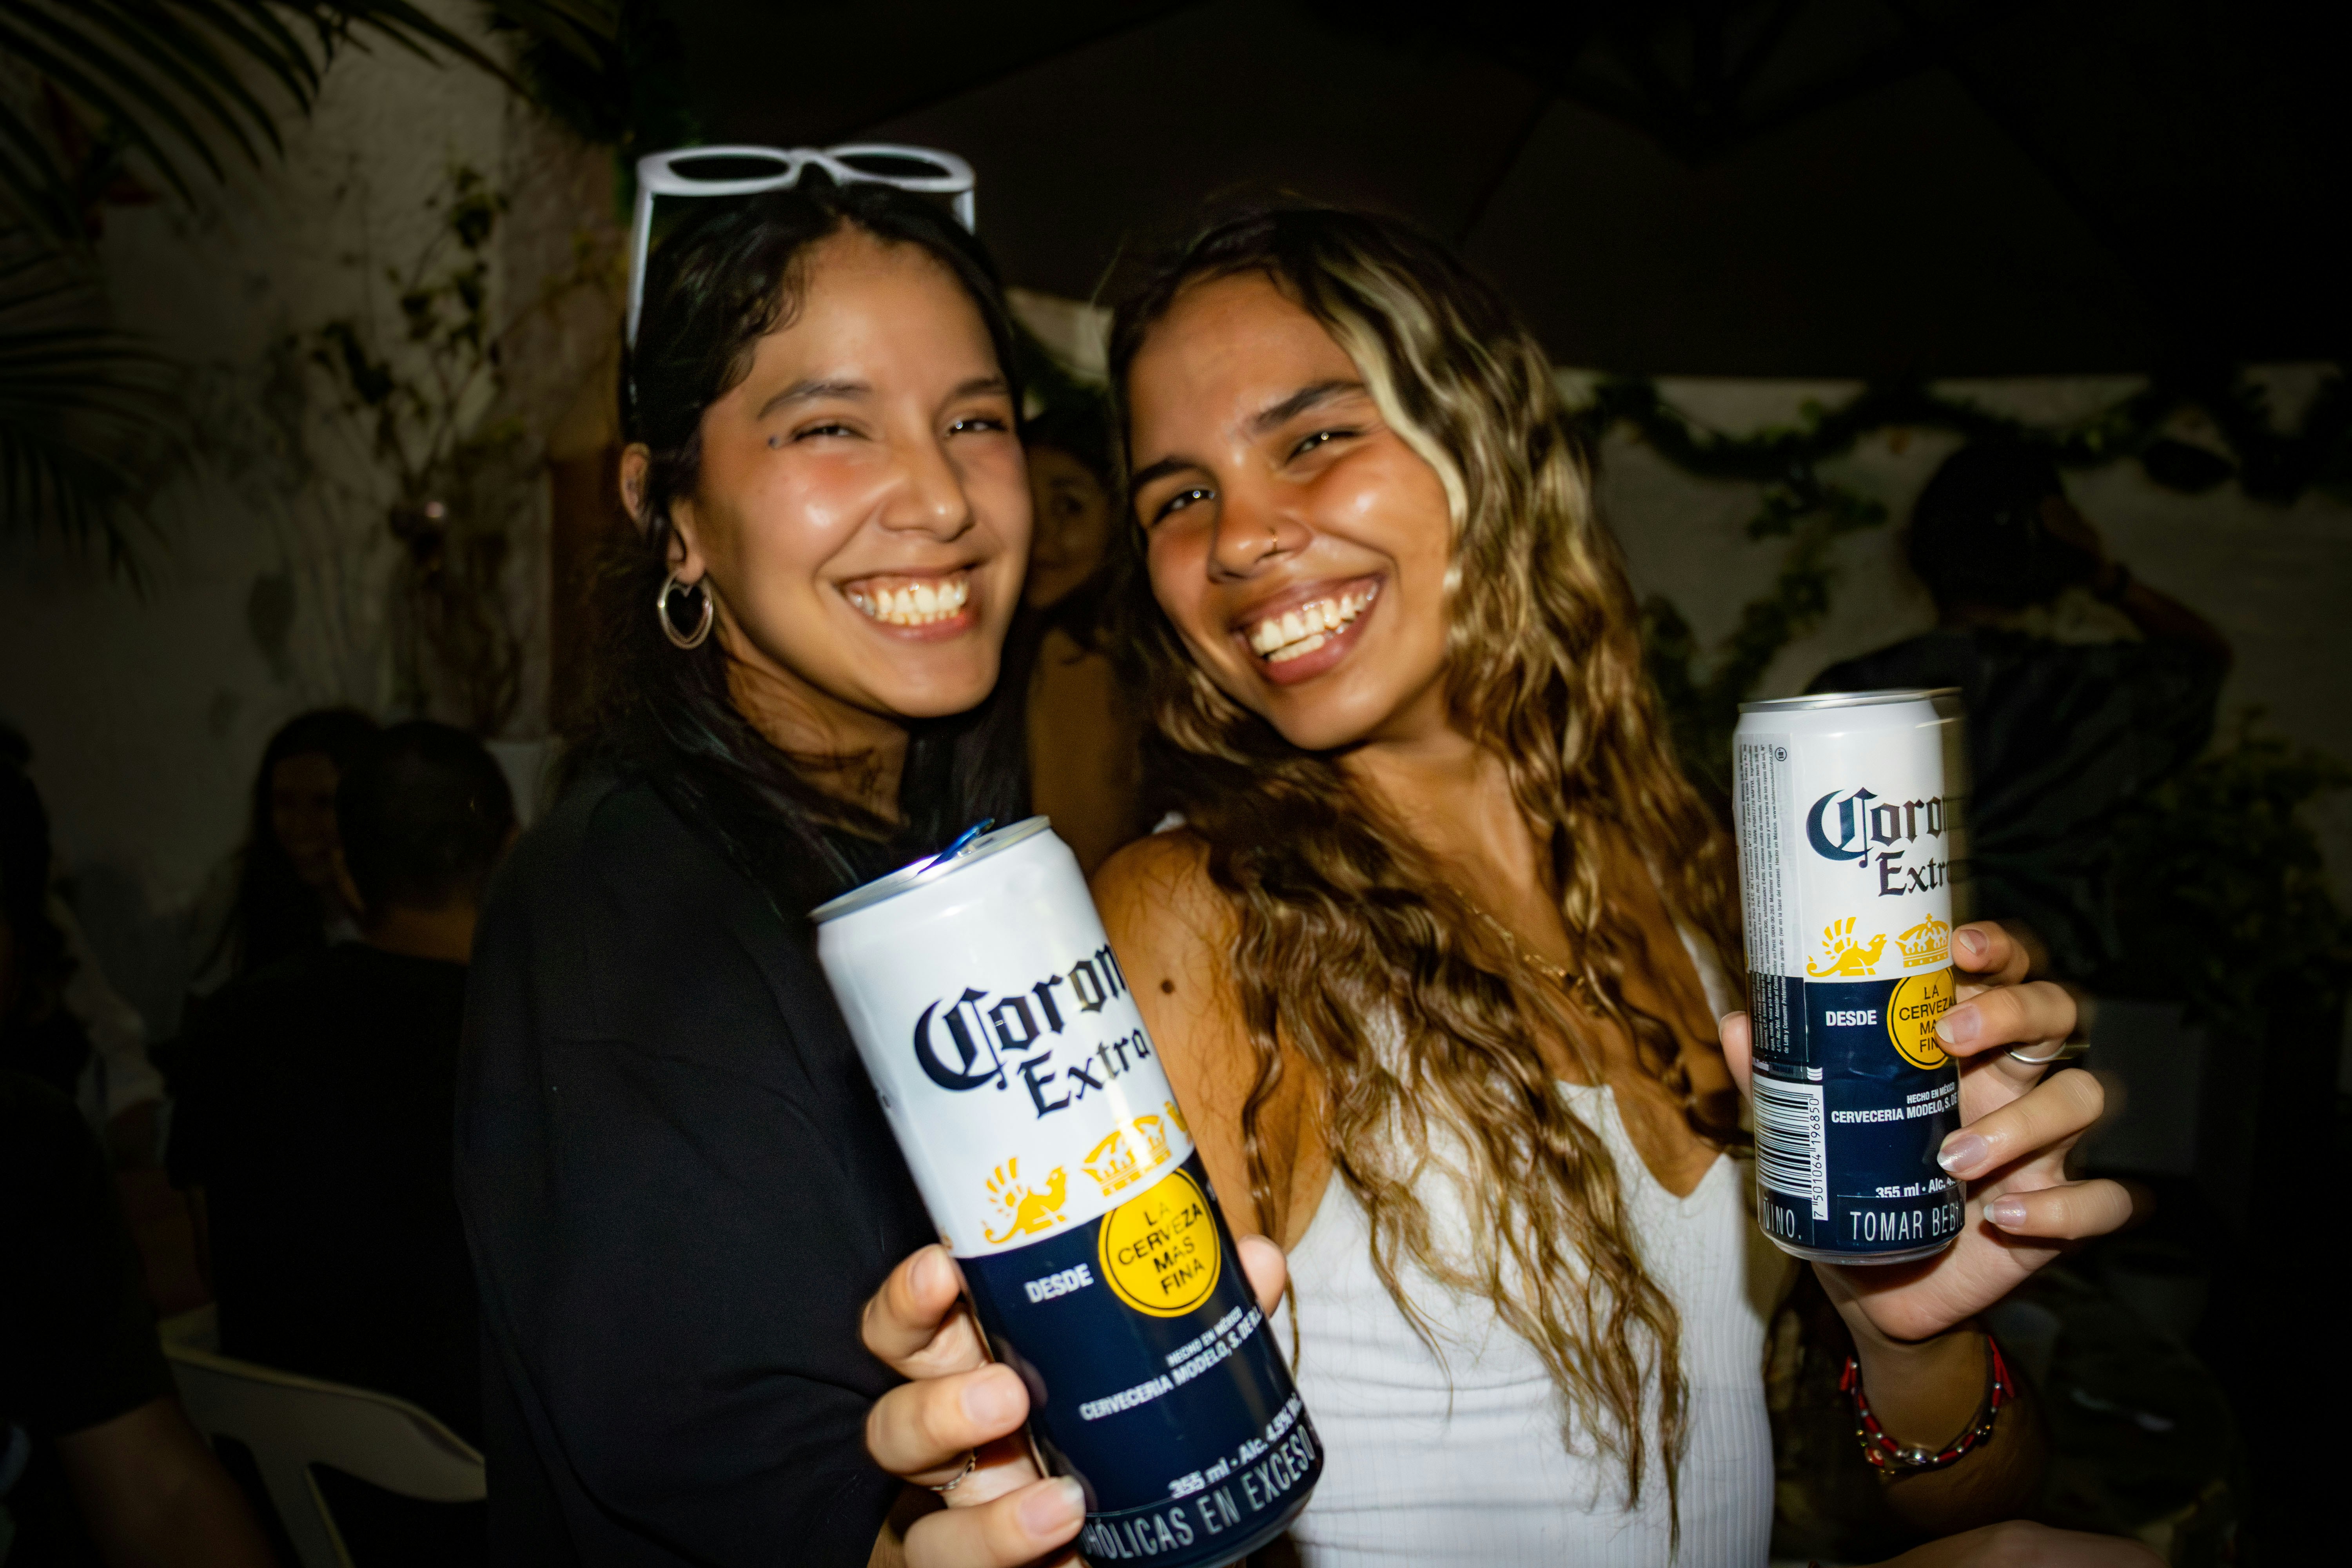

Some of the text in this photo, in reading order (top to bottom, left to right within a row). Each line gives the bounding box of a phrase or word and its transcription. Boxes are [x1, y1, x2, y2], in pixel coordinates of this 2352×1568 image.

[1806, 787, 1947, 869] Coro
[1875, 850, 1949, 897] Extr
[1924, 985, 1939, 1000] LA
[1826, 1010, 1877, 1026] DESDE
[1920, 1037, 1940, 1053] FIN
[1017, 1027, 1151, 1120] Extra
[1831, 1108, 1904, 1123] CERVECERIA
[1906, 1100, 1944, 1119] MODELO,
[1945, 1096, 1951, 1109] S.
[1907, 1082, 1955, 1104] HECHO EN MÉXICO
[1809, 1098, 1821, 1145] 196850
[1811, 1154, 1824, 1201] 501064
[1876, 1185, 1901, 1198] 355
[1904, 1182, 1919, 1197] ml
[1928, 1178, 1945, 1193] Alc.
[1143, 1202, 1172, 1226] LA
[1850, 1210, 1922, 1241] TOMAR
[1118, 1203, 1203, 1265] CERVEZA
[1024, 1262, 1094, 1304] DESDE
[1160, 1258, 1205, 1296] FINA
[1079, 1374, 1174, 1421] CERVECERIA
[1171, 1340, 1232, 1387] MODELO,
[1196, 1485, 1241, 1535] EN
[1240, 1424, 1316, 1512] EXCESO
[1204, 1456, 1230, 1484] ml
